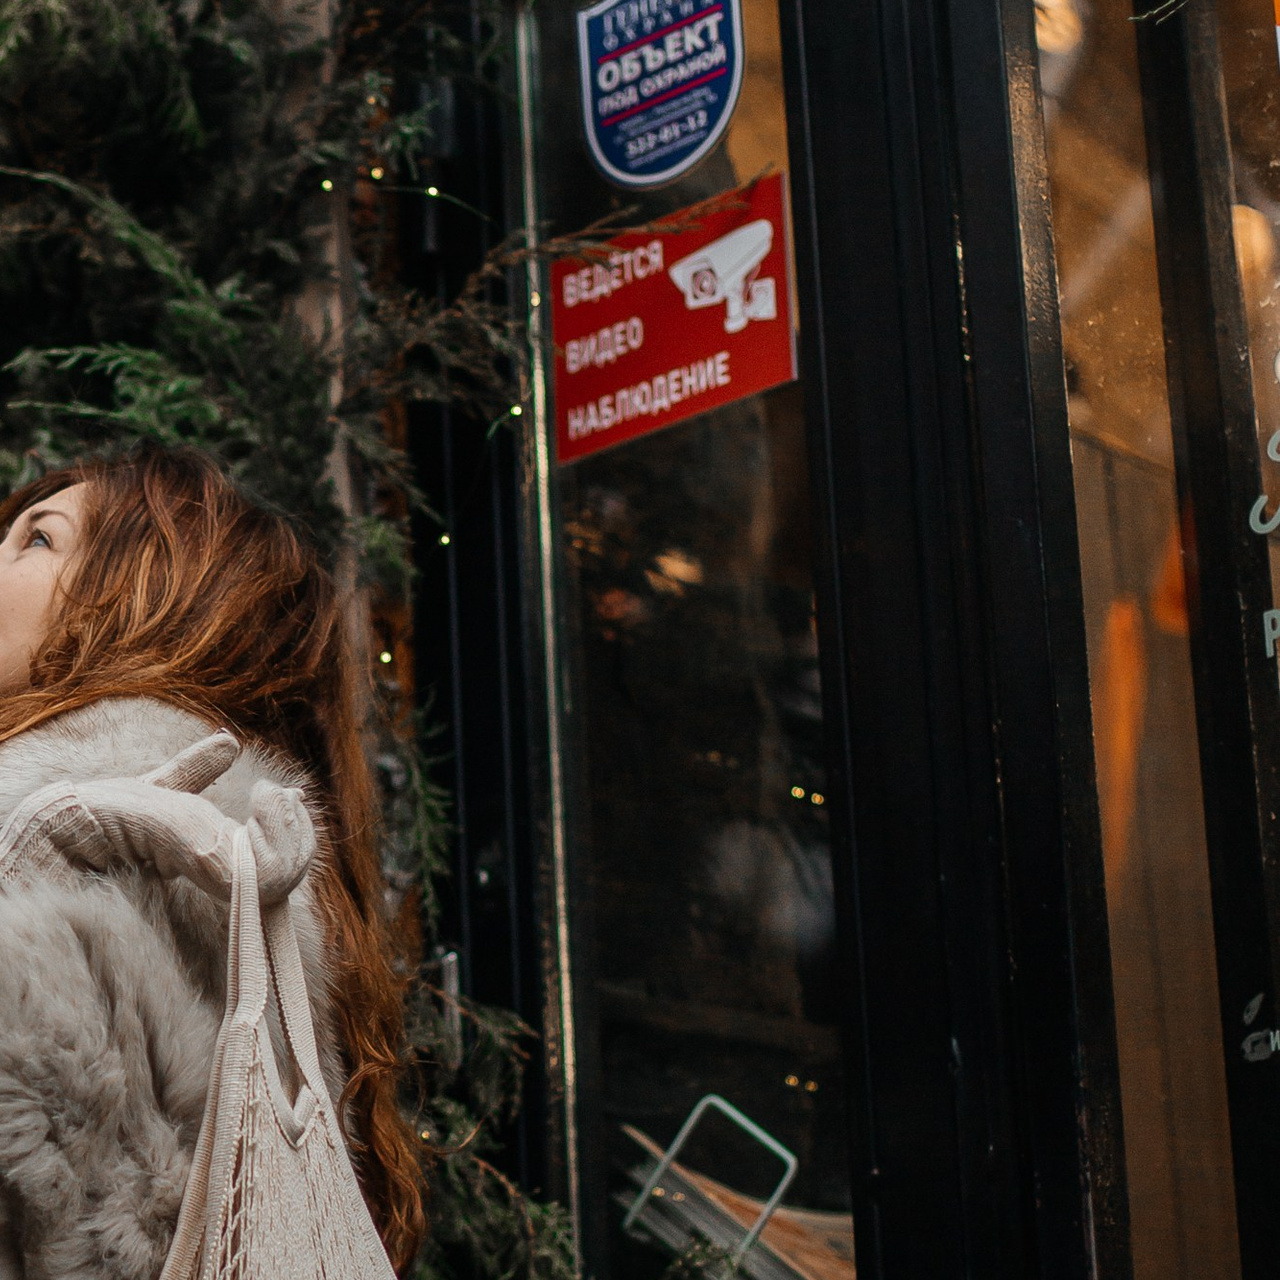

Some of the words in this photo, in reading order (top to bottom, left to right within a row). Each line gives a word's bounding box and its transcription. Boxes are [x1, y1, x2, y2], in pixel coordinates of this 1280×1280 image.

[597, 11, 724, 92] ОБЪЕКТ
[598, 84, 639, 117] ПОД
[639, 41, 727, 97] ОХРАНОЙ
[565, 316, 644, 374] ВИДЕО
[567, 350, 732, 441] НАБЛЮДЕНИЕ
